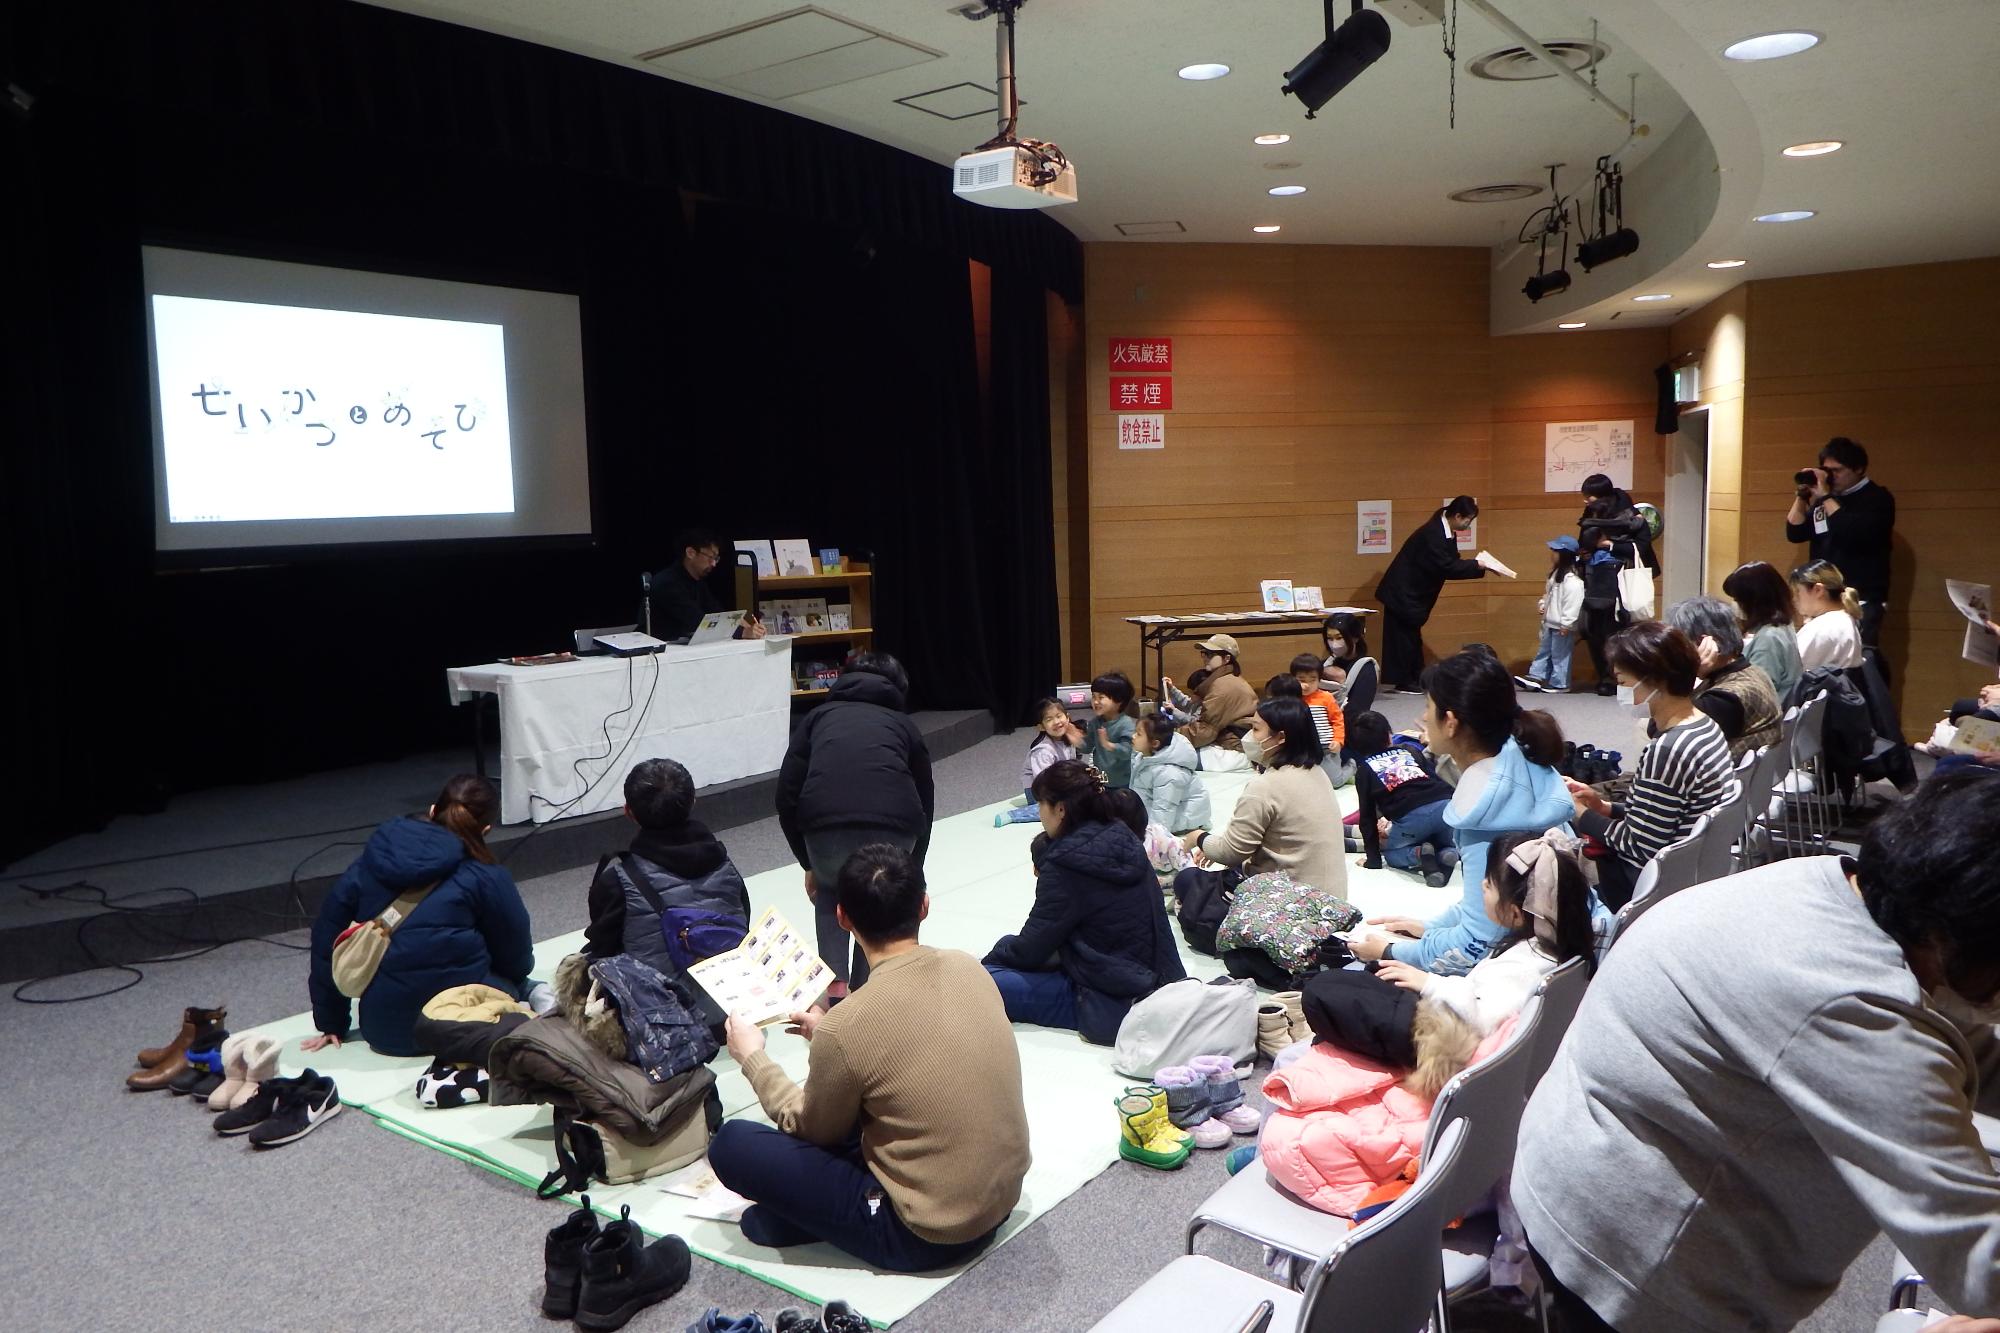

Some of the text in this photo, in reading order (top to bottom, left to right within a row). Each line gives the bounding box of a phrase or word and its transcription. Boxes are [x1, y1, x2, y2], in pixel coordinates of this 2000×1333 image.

[1113, 343, 1169, 364] 火気厳禁
[1120, 383, 1161, 404] 禁煙
[1122, 418, 1161, 444] 飲食禁止
